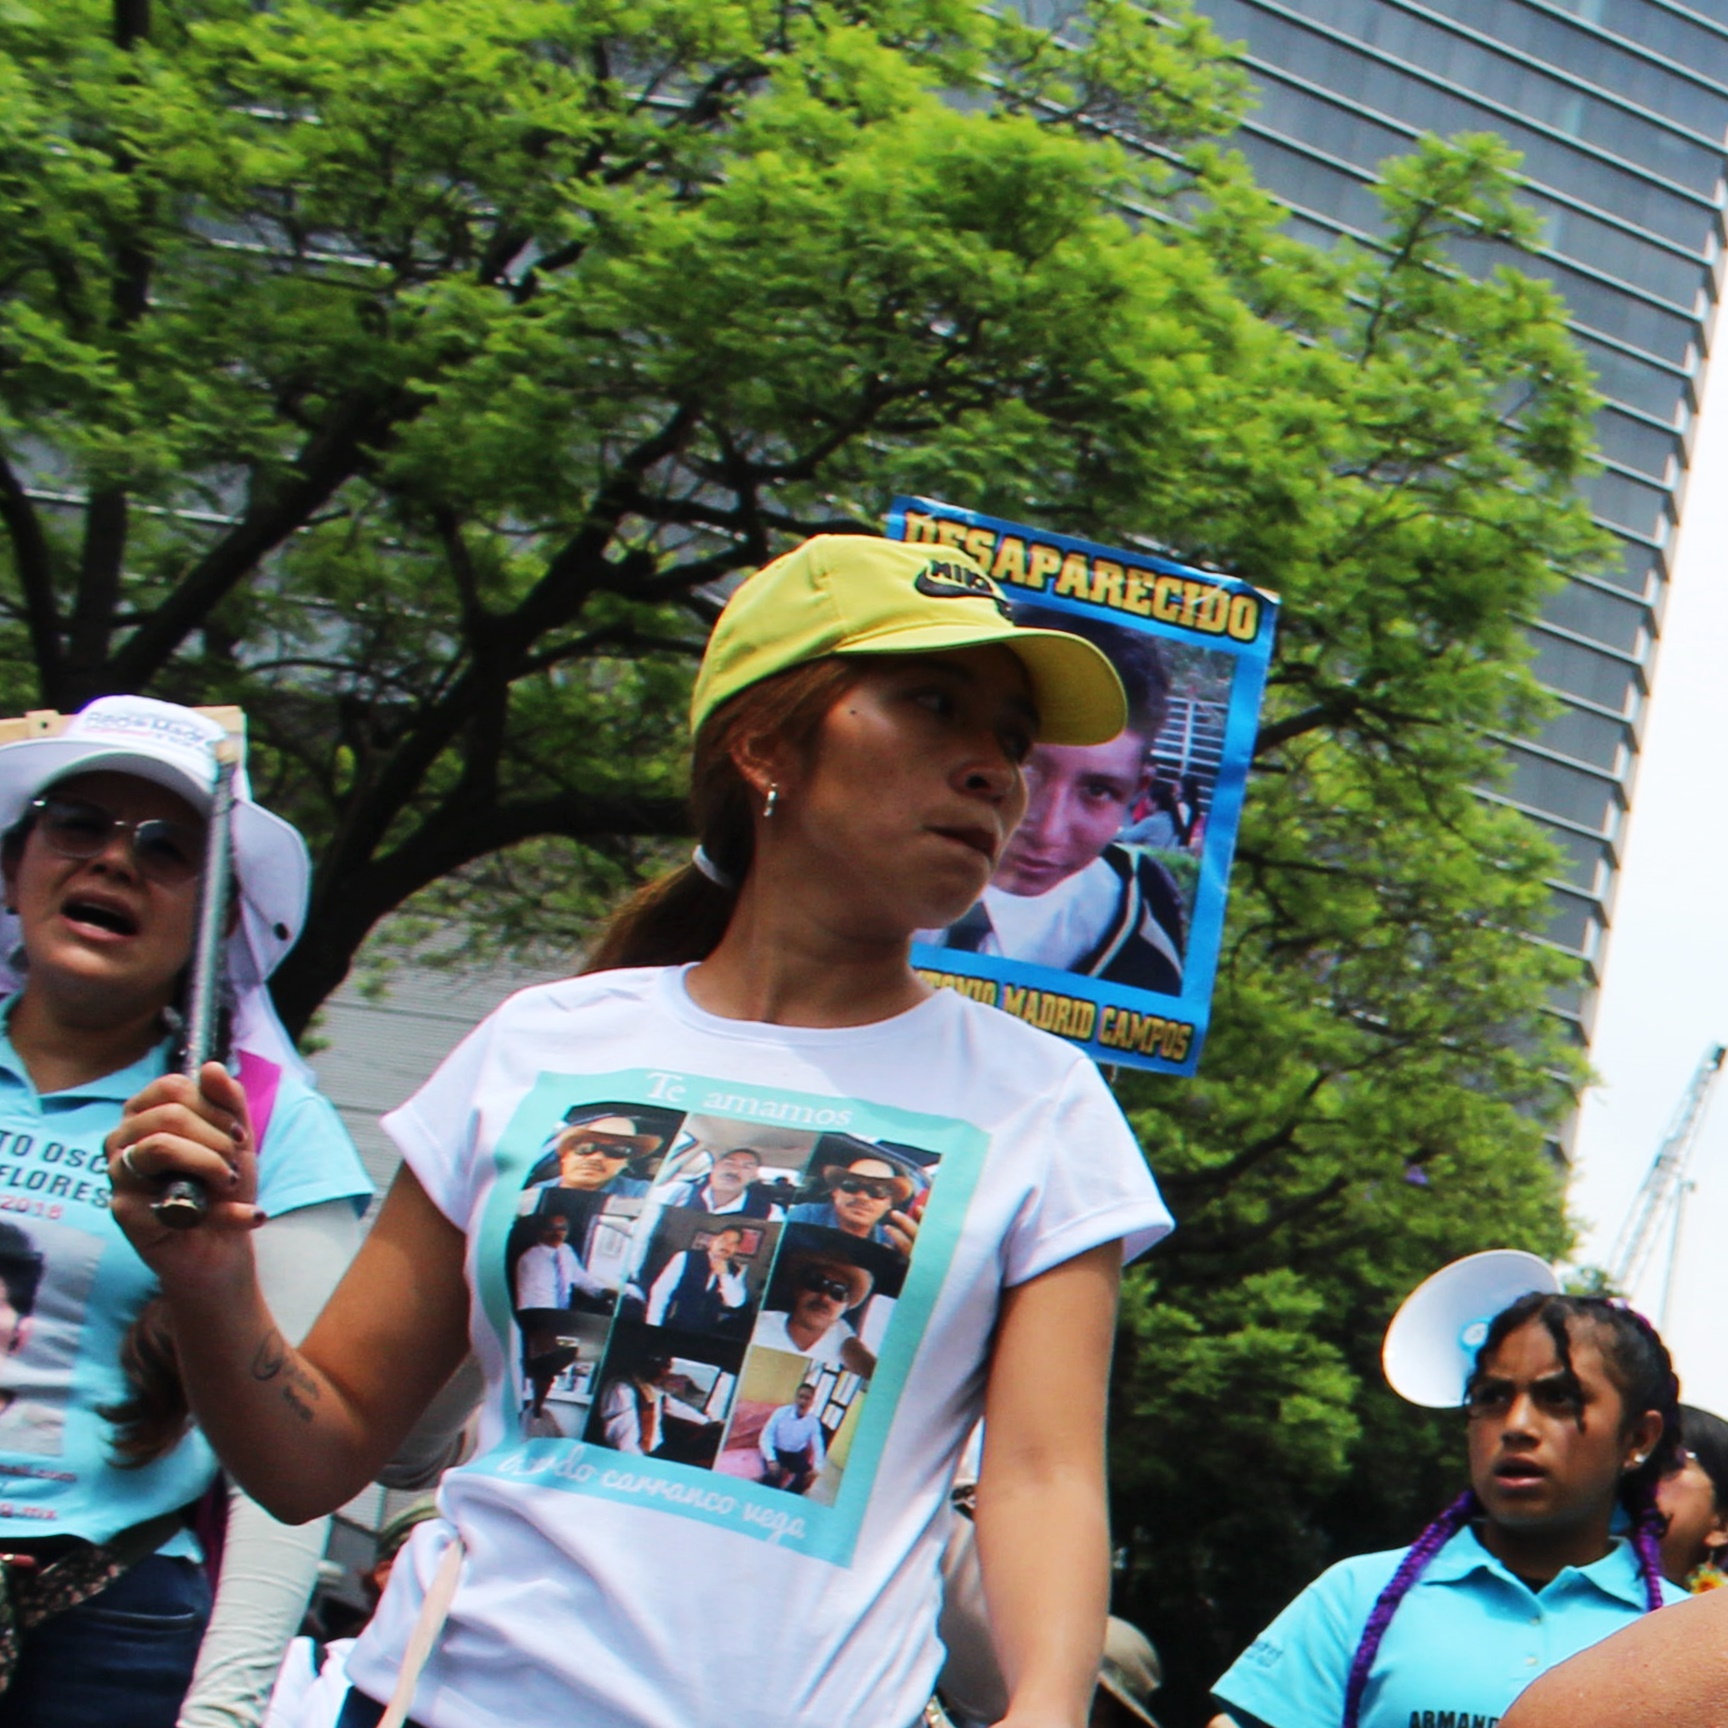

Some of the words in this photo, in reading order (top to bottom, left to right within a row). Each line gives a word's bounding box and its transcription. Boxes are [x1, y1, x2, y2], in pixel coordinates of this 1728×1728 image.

[1002, 983, 1096, 1041] MADRID
[1099, 1005, 1193, 1064] CAMPOS
[645, 1071, 688, 1102] Te
[700, 1090, 854, 1127] amamos
[601, 1469, 739, 1515] carranco
[743, 1499, 806, 1545] vega
